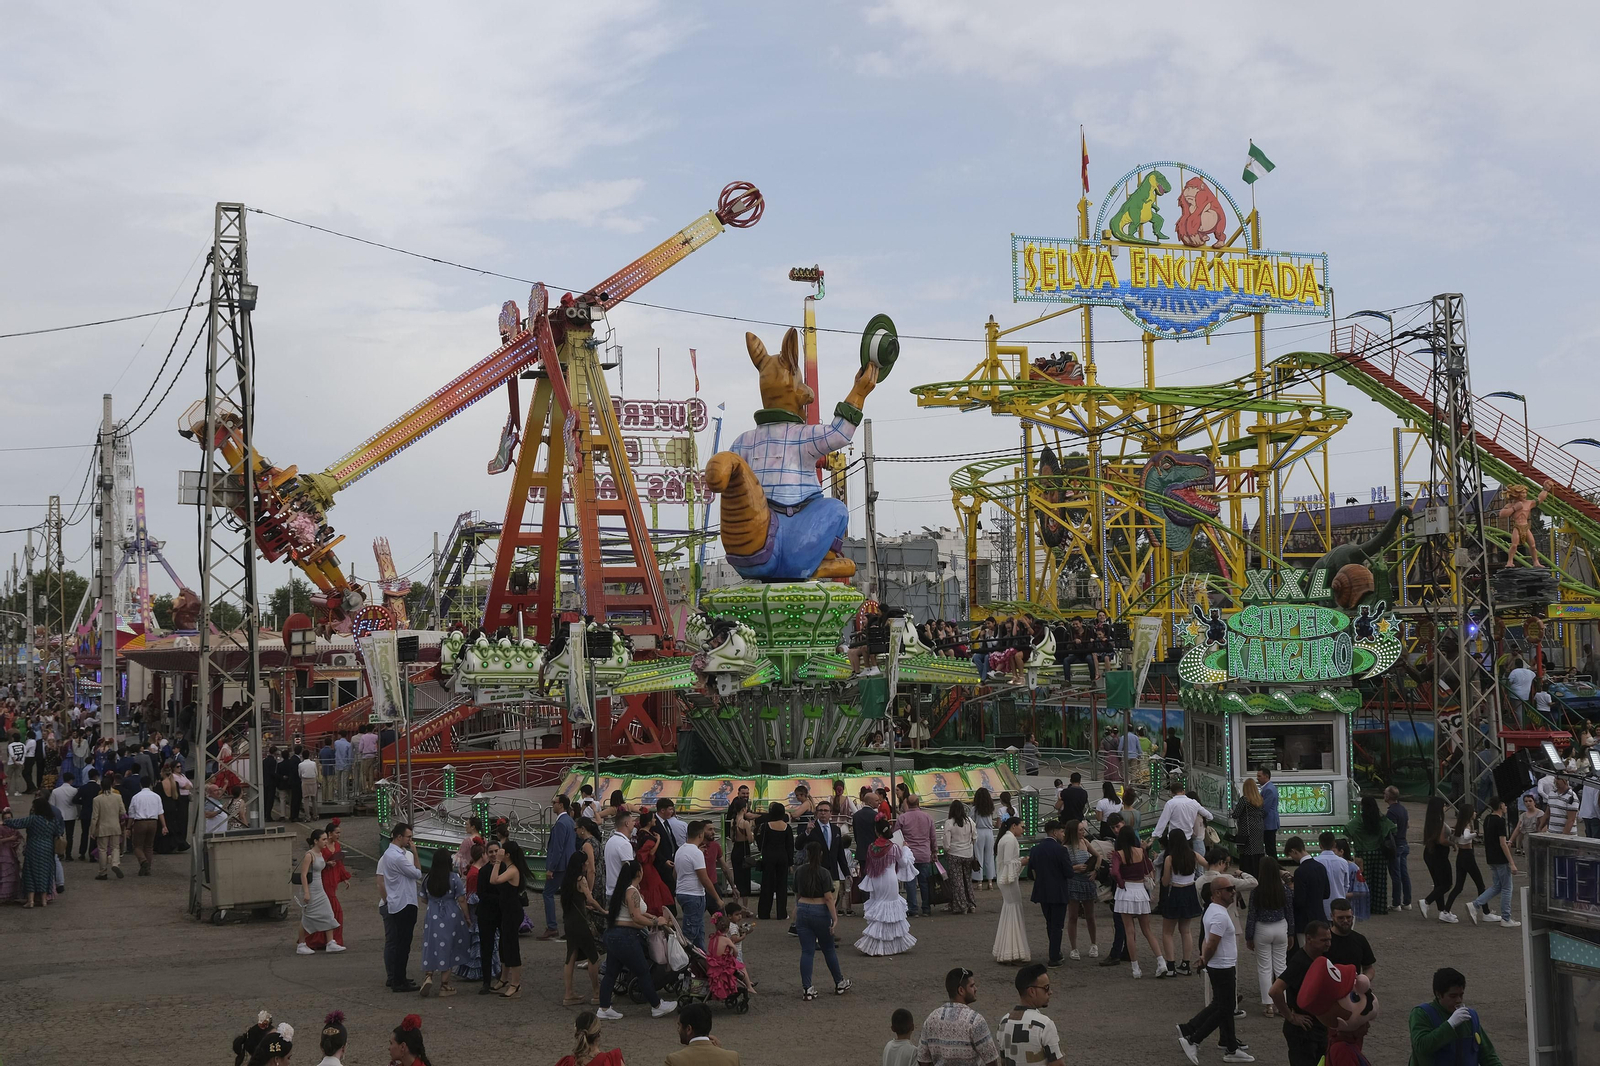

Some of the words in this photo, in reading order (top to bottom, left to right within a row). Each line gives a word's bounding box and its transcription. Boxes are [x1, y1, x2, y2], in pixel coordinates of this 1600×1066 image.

[1024, 243, 1120, 293] SELVA
[1130, 248, 1323, 306] ENCANTADA
[1241, 569, 1332, 601] XXL
[1241, 605, 1338, 639] SUPER
[1227, 631, 1353, 680] KANGURO
[413, 710, 463, 743] MAXIMA
[1277, 786, 1315, 798] UPER
[1277, 796, 1327, 813] NGURO
